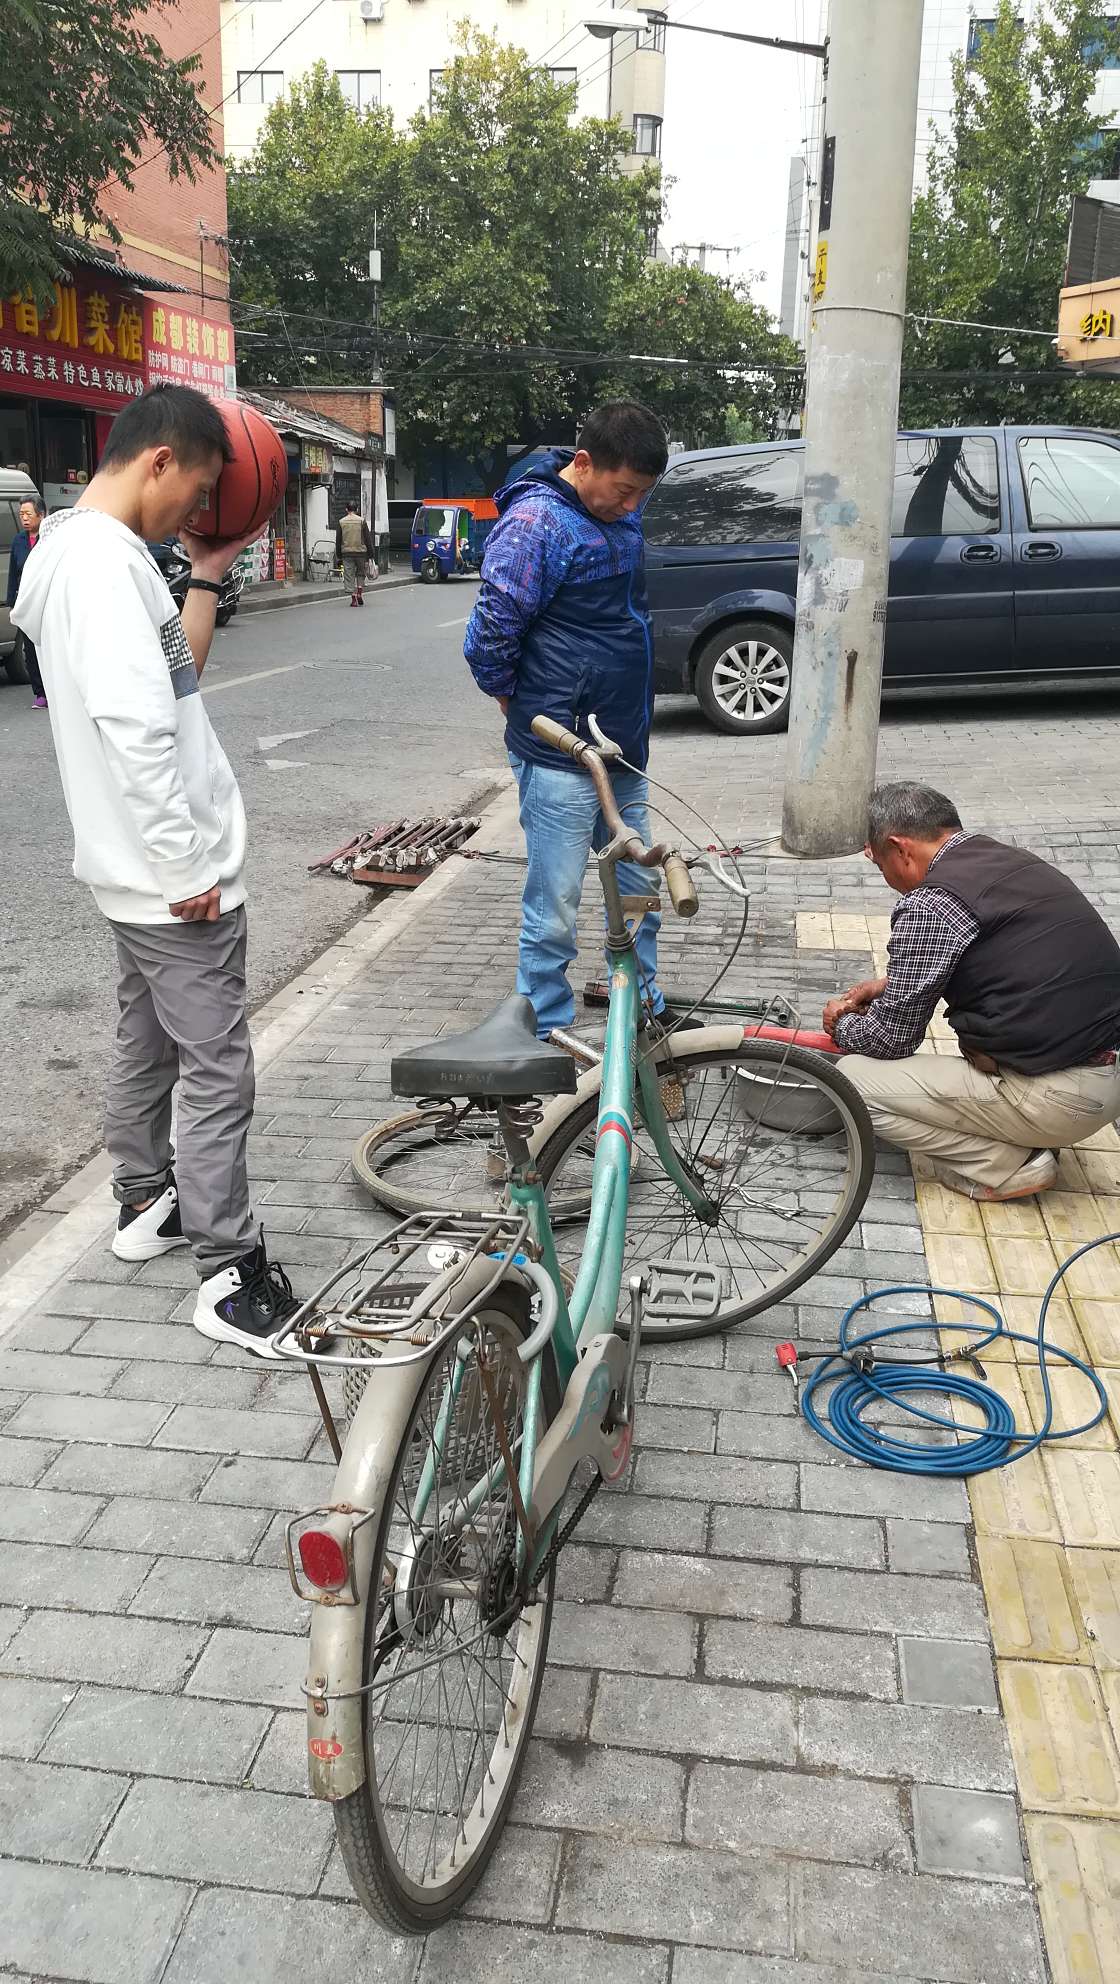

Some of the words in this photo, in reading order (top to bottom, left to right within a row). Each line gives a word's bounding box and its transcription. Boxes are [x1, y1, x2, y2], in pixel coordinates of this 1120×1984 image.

[152, 307, 229, 363] 成都装饰部
[1080, 307, 1112, 338] 纳
[63, 360, 101, 388] 特色鱼
